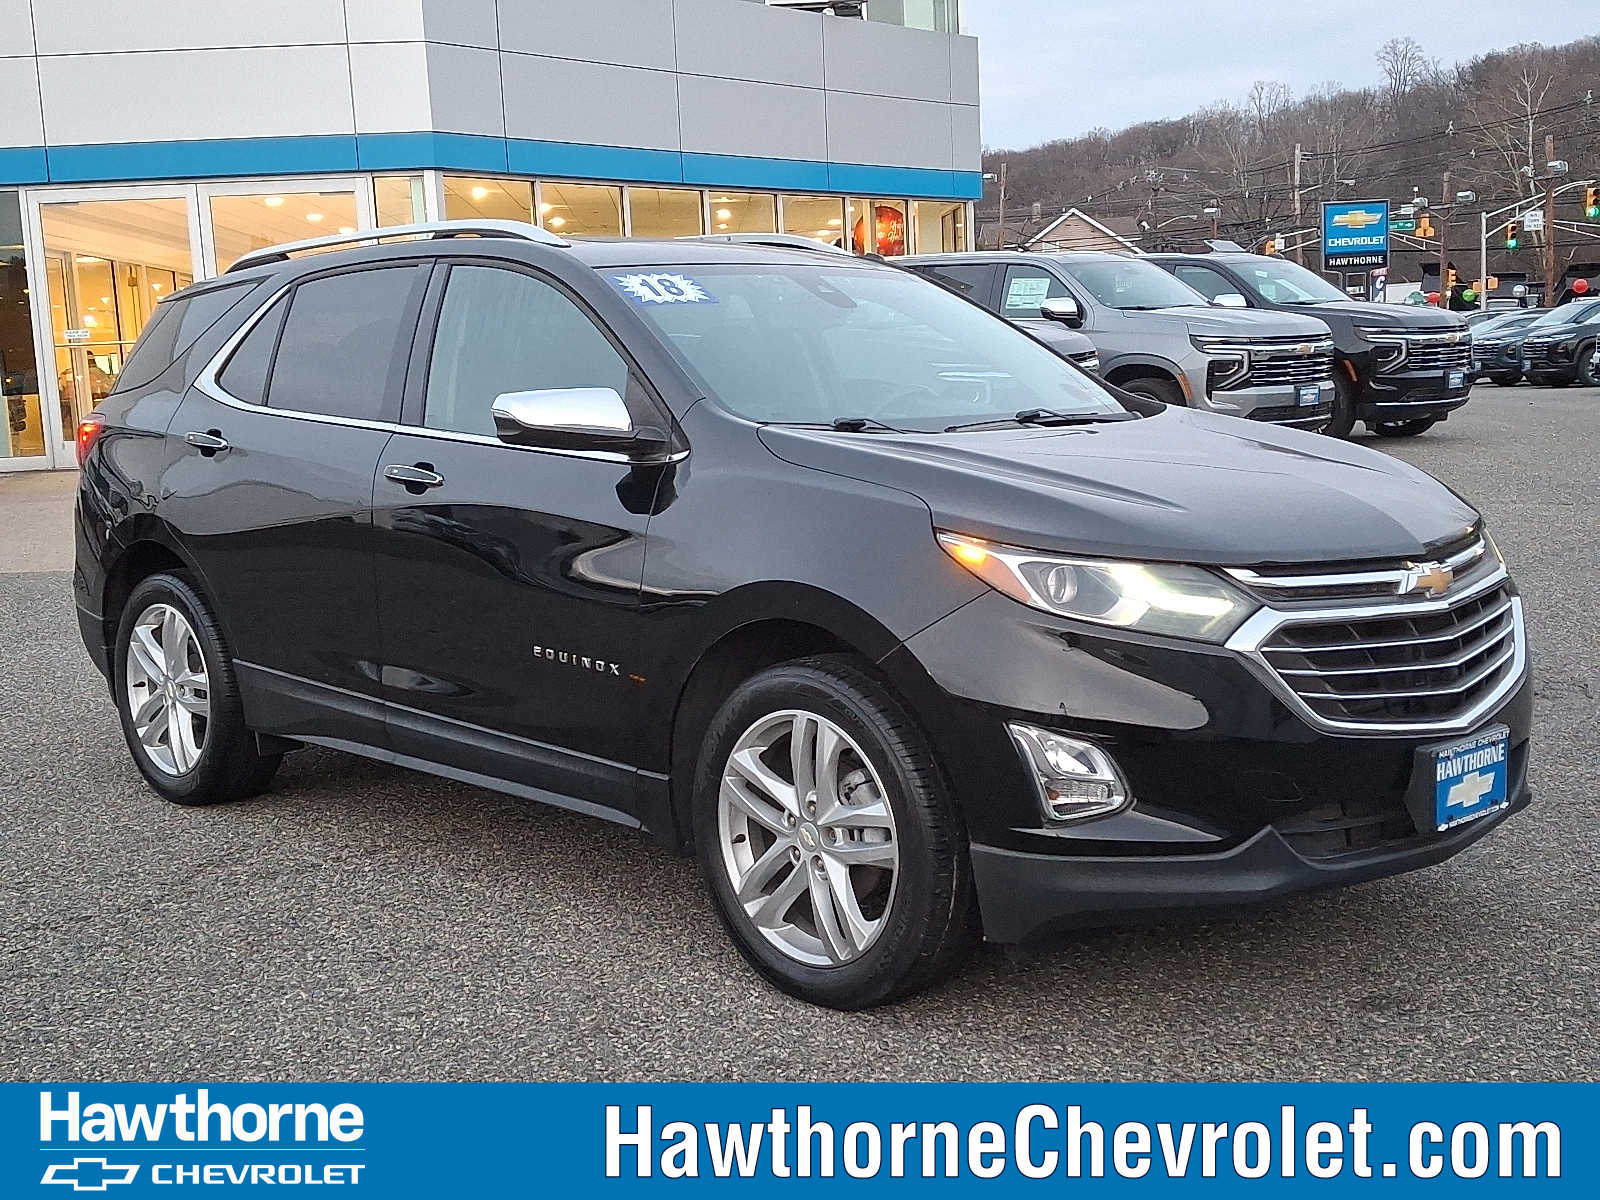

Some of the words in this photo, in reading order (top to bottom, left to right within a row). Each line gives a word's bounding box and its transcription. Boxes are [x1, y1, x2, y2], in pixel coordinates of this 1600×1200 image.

[1328, 236, 1385, 247] CHEVROLET
[1329, 255, 1384, 266] HAWTHORNE
[640, 279, 685, 297] 18
[533, 645, 620, 676] EQUINOX
[1436, 743, 1506, 782] HAWTHORNE
